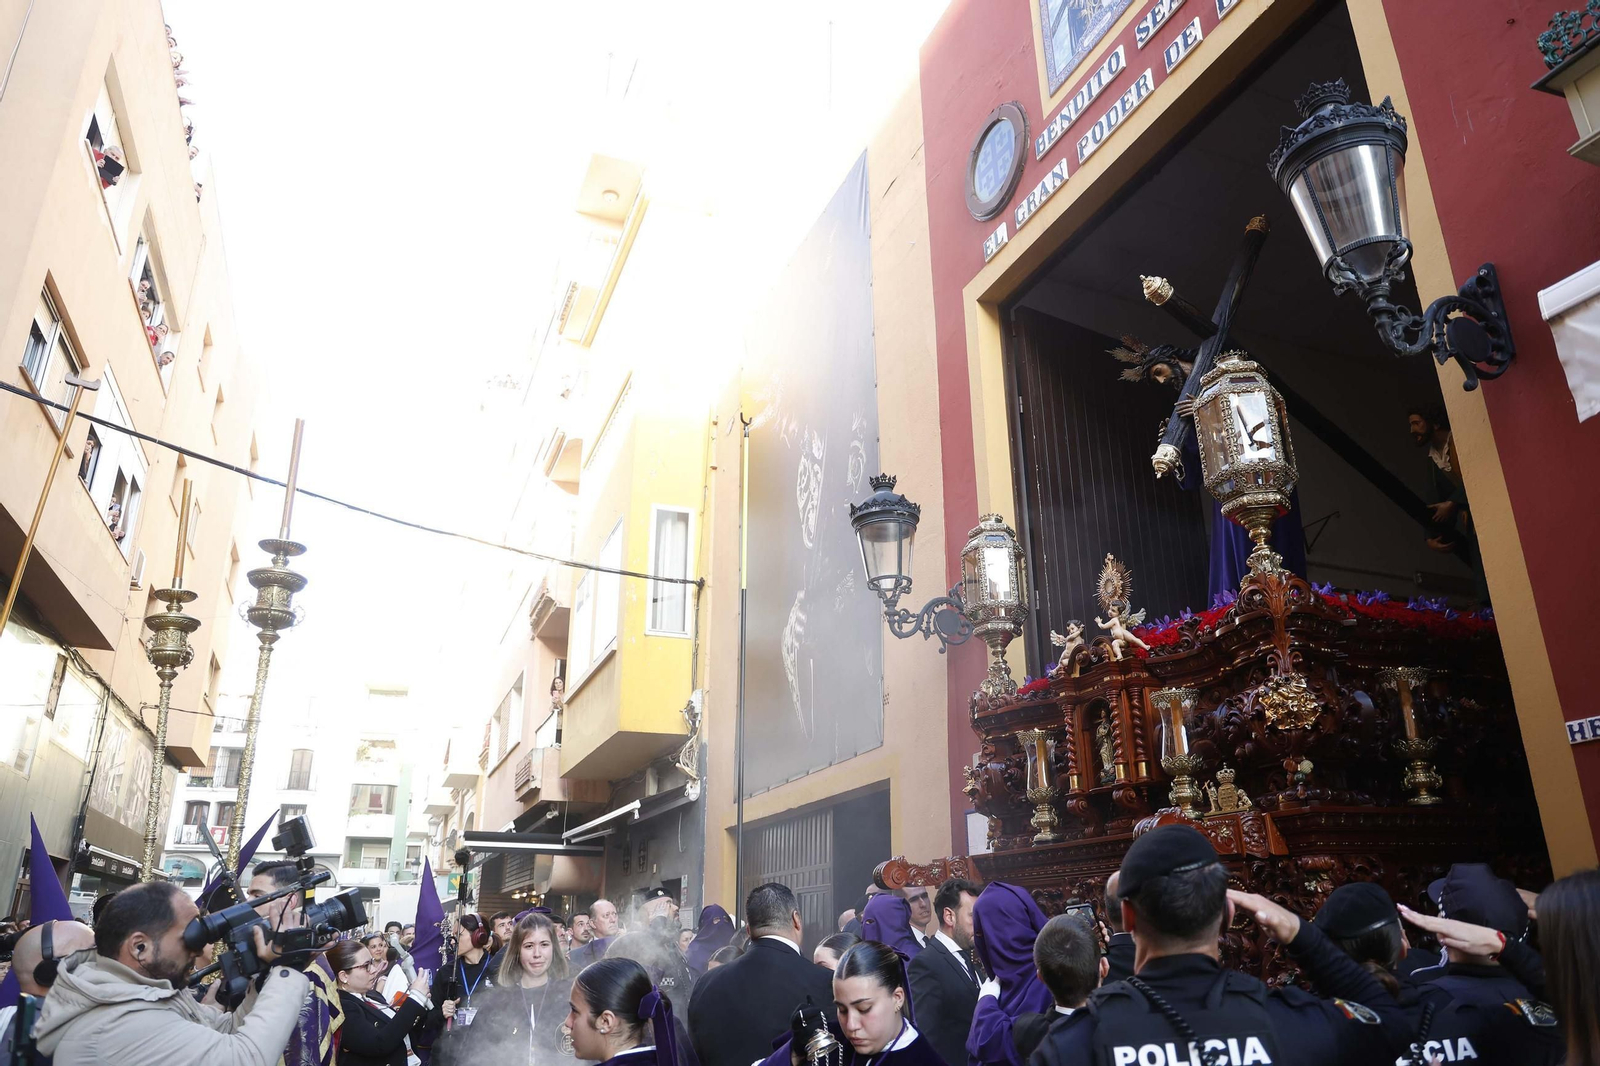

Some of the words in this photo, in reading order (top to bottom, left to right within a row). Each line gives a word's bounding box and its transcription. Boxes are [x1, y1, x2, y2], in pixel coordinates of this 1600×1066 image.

[984, 231, 1005, 258] EL
[1014, 161, 1065, 226] GRAN
[1078, 74, 1150, 159] PODER
[1165, 21, 1198, 68] DE
[1035, 51, 1120, 156] BENDITO
[1113, 1037, 1272, 1066] POLICIA
